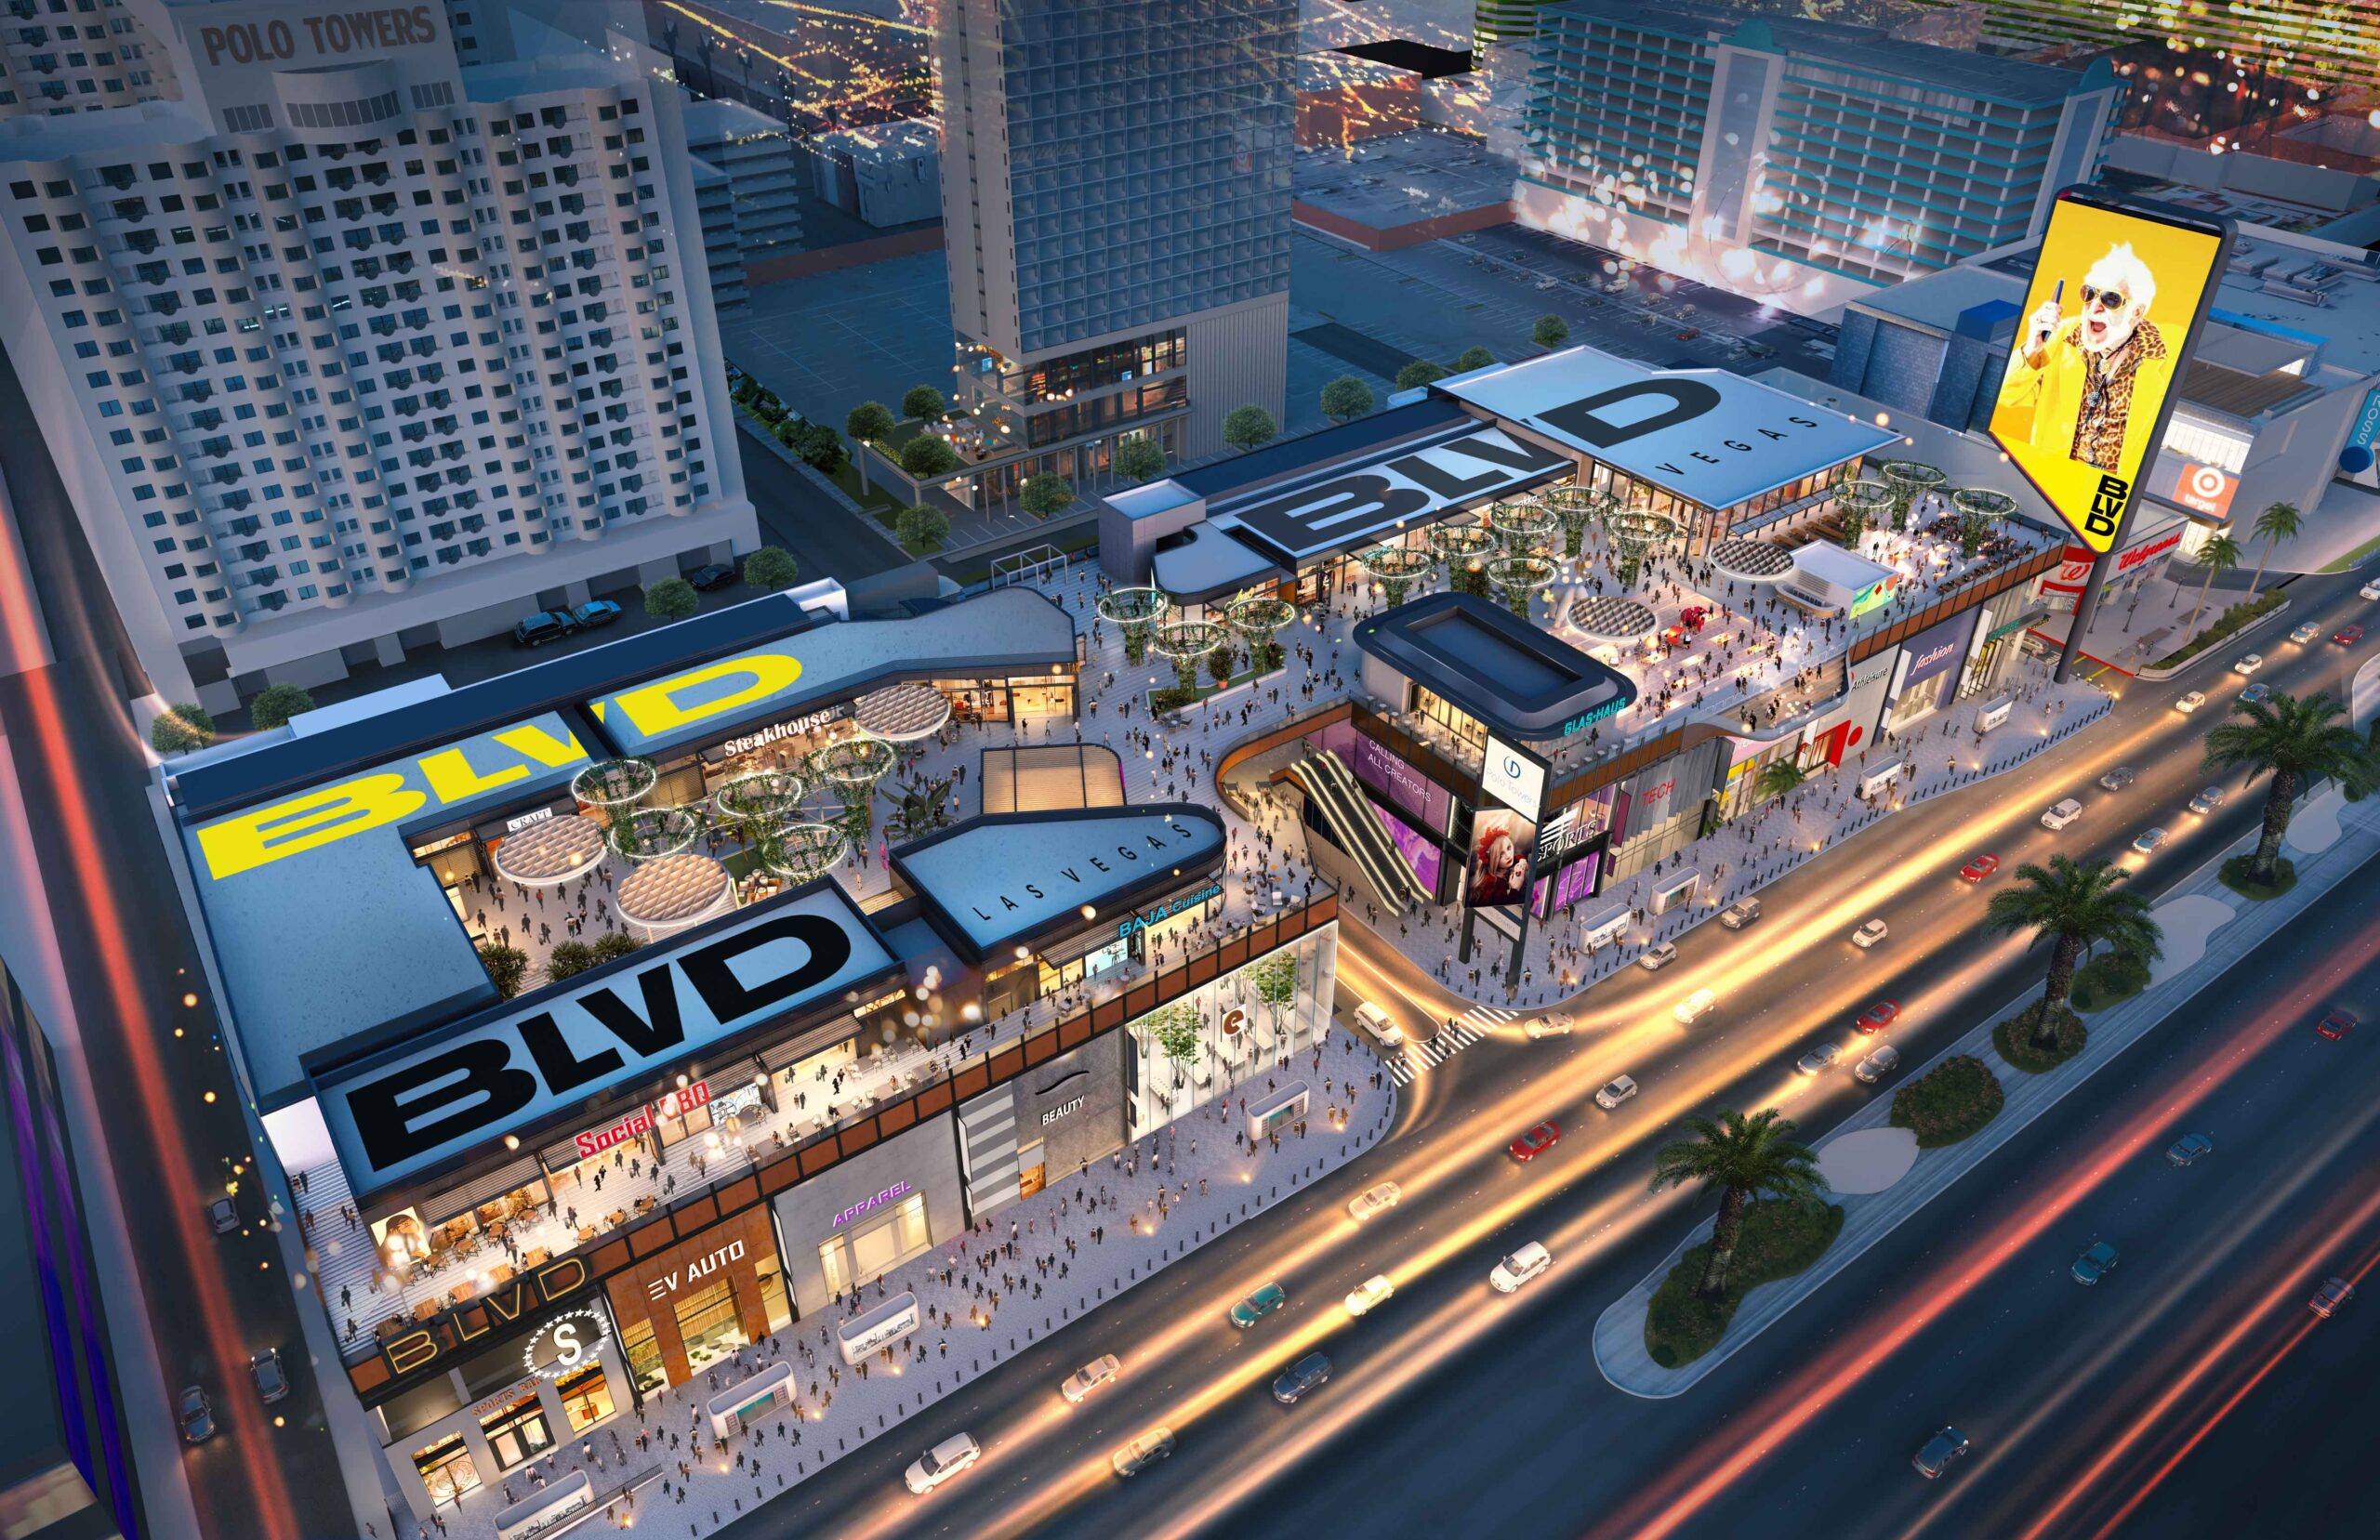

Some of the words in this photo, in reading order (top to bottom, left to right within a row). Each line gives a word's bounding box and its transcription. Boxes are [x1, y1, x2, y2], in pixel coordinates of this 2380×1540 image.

[201, 20, 295, 66] POLO
[303, 6, 436, 54] TOWERS
[1235, 377, 1721, 550] BLVD
[1655, 416, 1818, 476] VEGAS
[2118, 531, 2182, 572] Walgreens
[1910, 641, 1955, 677] fashion
[724, 709, 830, 757] Steakhouse
[1368, 740, 1405, 770] CALLING
[196, 653, 803, 881] BLVD
[1368, 753, 1382, 770] ALL
[1384, 764, 1432, 802] CREATORS
[1641, 776, 1676, 807] TECH
[972, 884, 1044, 921] LAS
[1061, 823, 1193, 884] VEGAS
[1118, 905, 1169, 938] BAJA
[1171, 885, 1221, 914] Cuisine
[346, 914, 851, 1171] BLVD
[575, 1104, 654, 1159] Social
[1041, 1094, 1085, 1126] BEAUTY
[833, 1180, 913, 1228] APPAREL
[648, 1270, 678, 1301] EV
[687, 1239, 745, 1283] AUTO
[385, 1256, 588, 1375] BLVD
[553, 1323, 582, 1366] S
[470, 1389, 516, 1418] SPORTS
[518, 1375, 544, 1396] BAR
